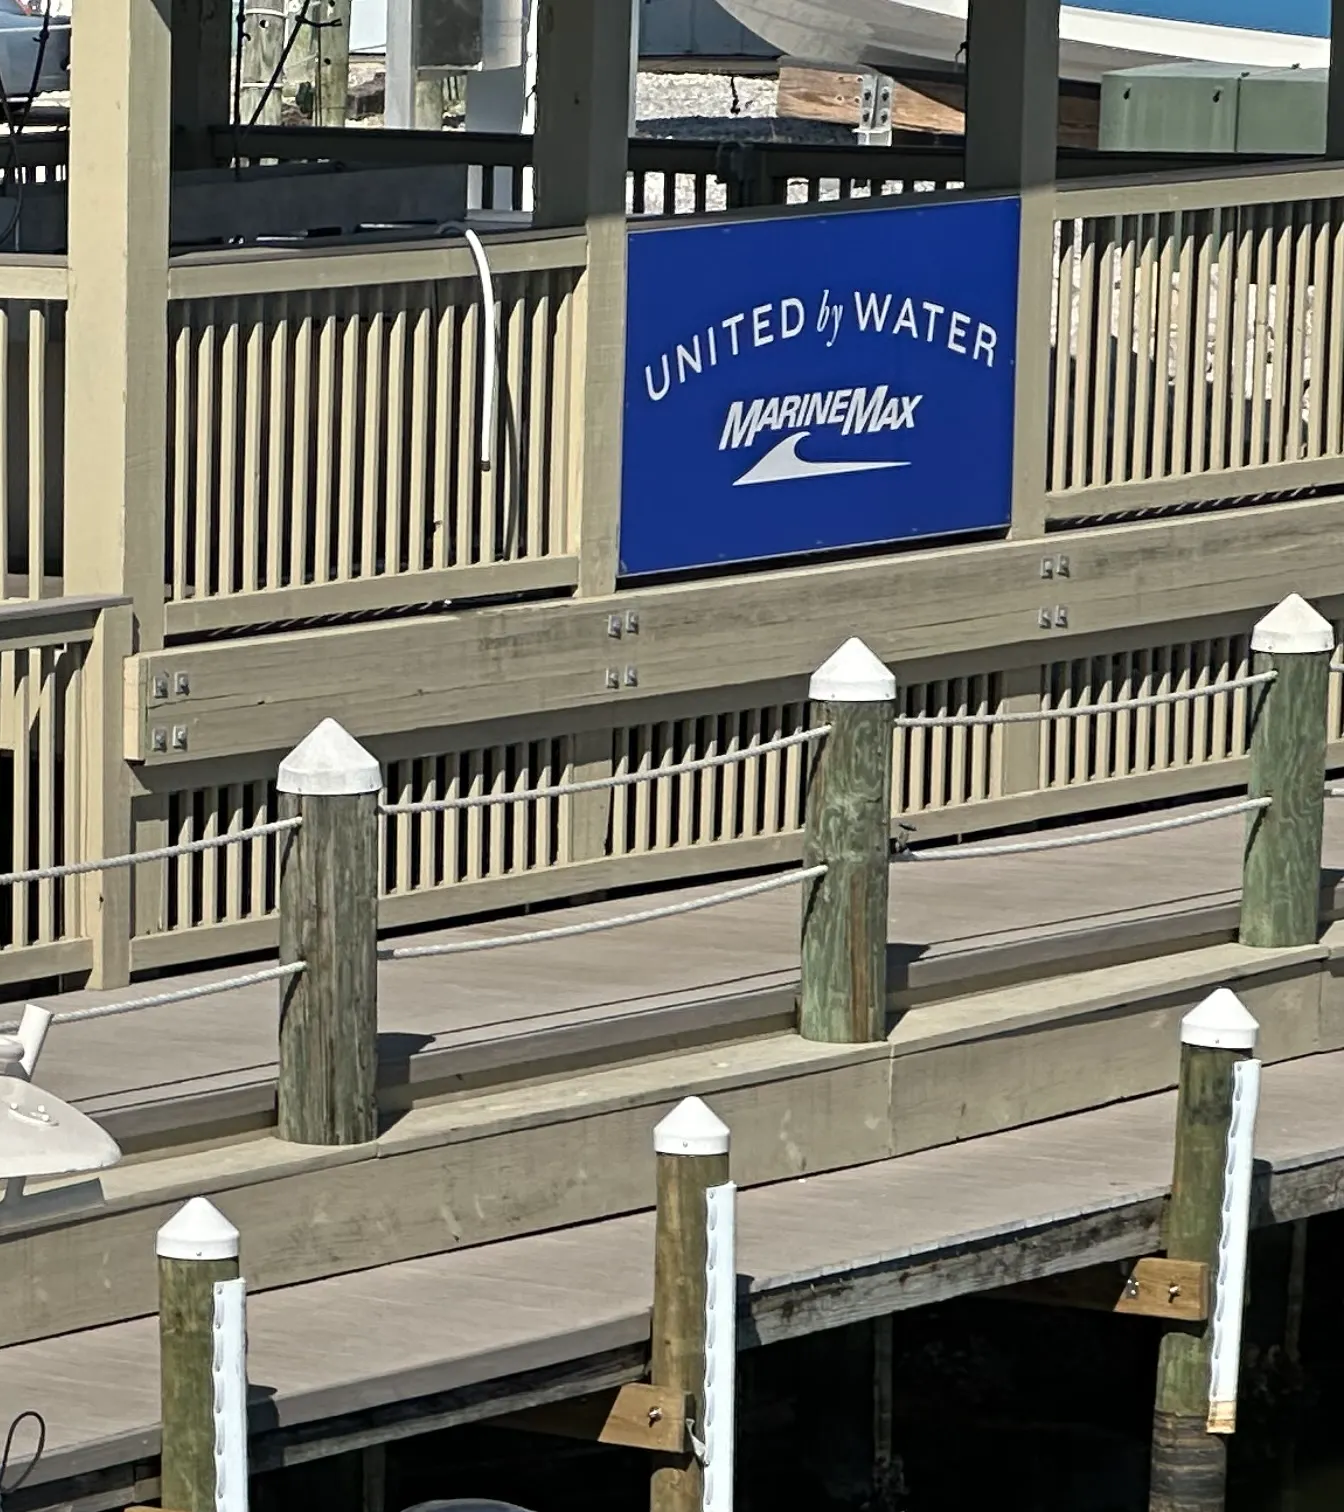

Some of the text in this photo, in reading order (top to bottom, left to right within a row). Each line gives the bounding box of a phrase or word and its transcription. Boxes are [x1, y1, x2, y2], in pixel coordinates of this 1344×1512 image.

[644, 289, 998, 401] UNITED by WATER
